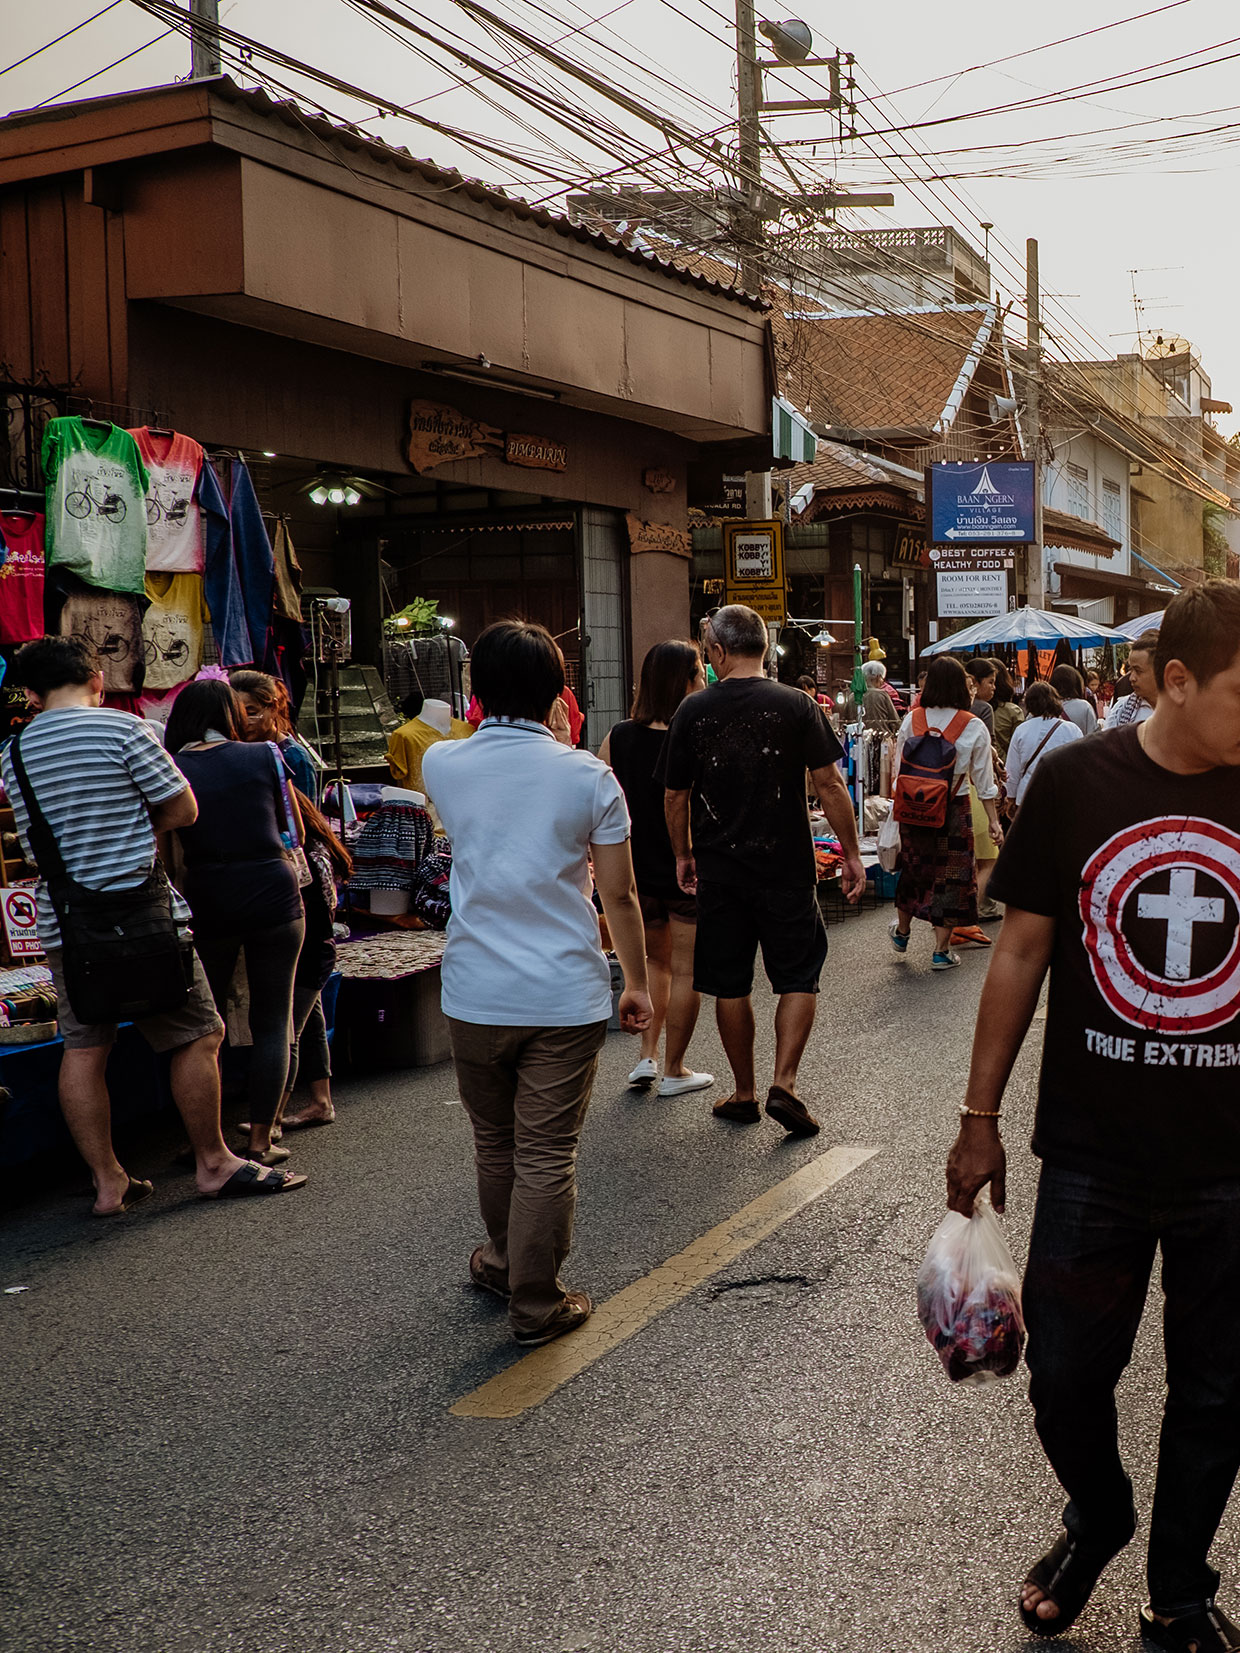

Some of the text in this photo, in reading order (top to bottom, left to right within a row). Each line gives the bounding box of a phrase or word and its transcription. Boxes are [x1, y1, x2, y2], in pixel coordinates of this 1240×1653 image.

[508, 442, 567, 466] PIMPAIRIN
[957, 494, 1015, 504] BAAN NGERN
[956, 513, 988, 525] บ้านเงิน
[941, 548, 1015, 557] BEST COFFEE &
[933, 560, 1001, 569] HEALTHY FOOD
[941, 574, 1002, 583] ROOM FOR RENT
[10, 927, 38, 938] ห้ามถ่าย
[12, 941, 23, 951] NO
[1085, 1028, 1136, 1063] TRUE
